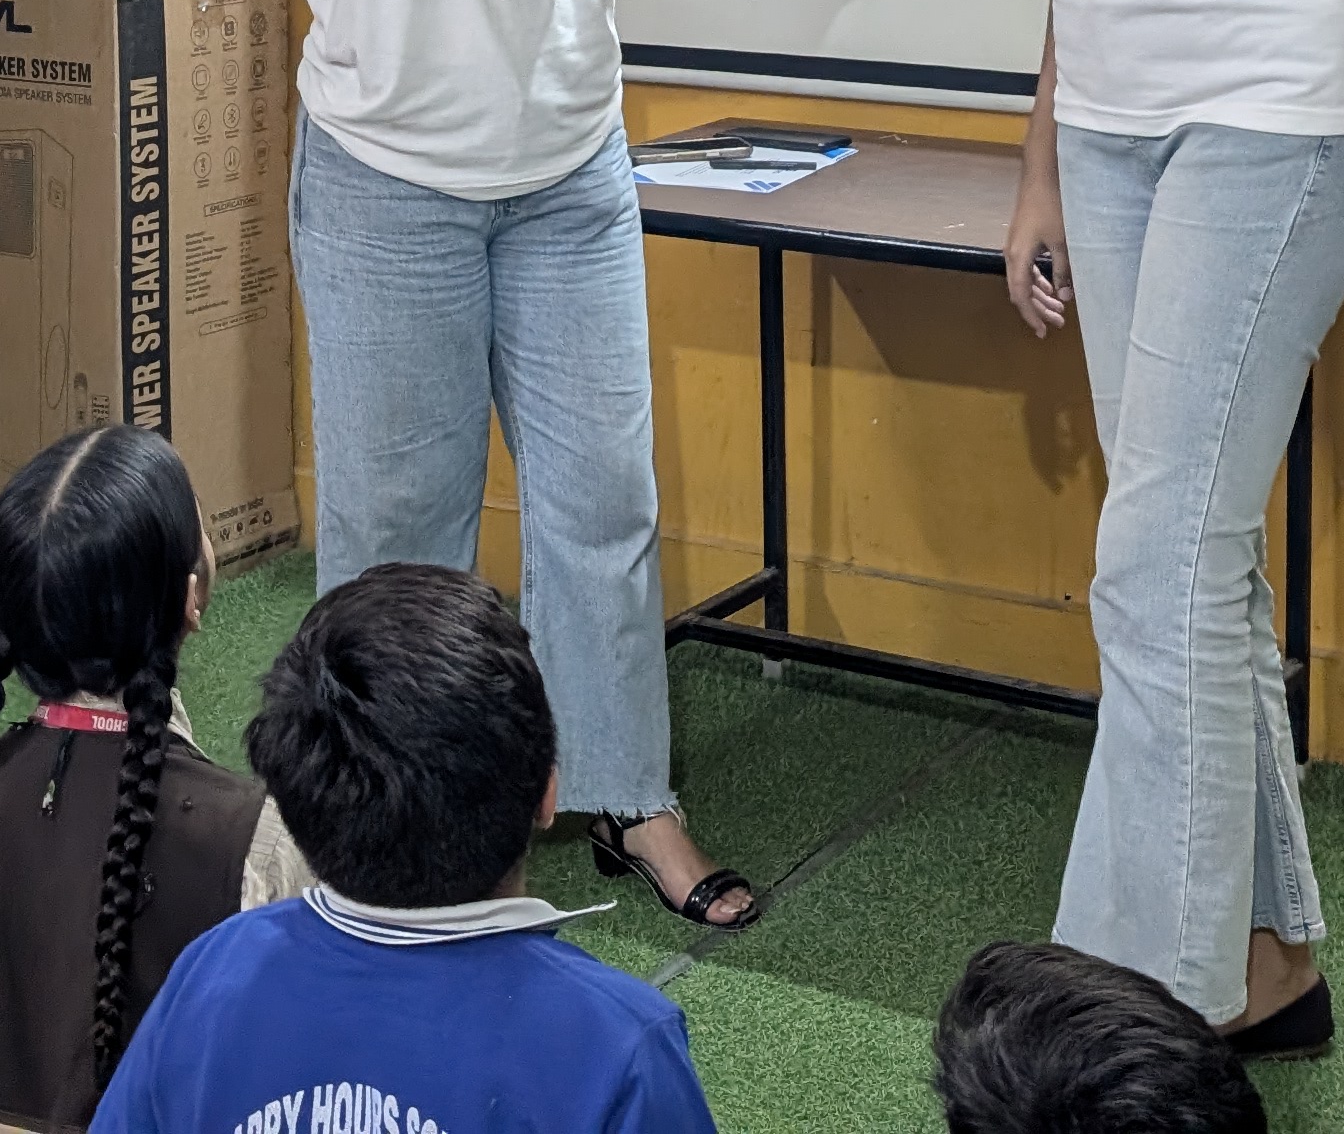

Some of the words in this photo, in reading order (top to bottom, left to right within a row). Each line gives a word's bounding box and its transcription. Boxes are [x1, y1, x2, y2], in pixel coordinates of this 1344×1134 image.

[14, 87, 53, 102] SPEAKER
[56, 91, 92, 106] SYSTEM
[31, 58, 92, 83] SYSTEM
[131, 76, 160, 203] SYSTEM
[132, 210, 161, 354] SPEAKER
[133, 360, 162, 431] WER
